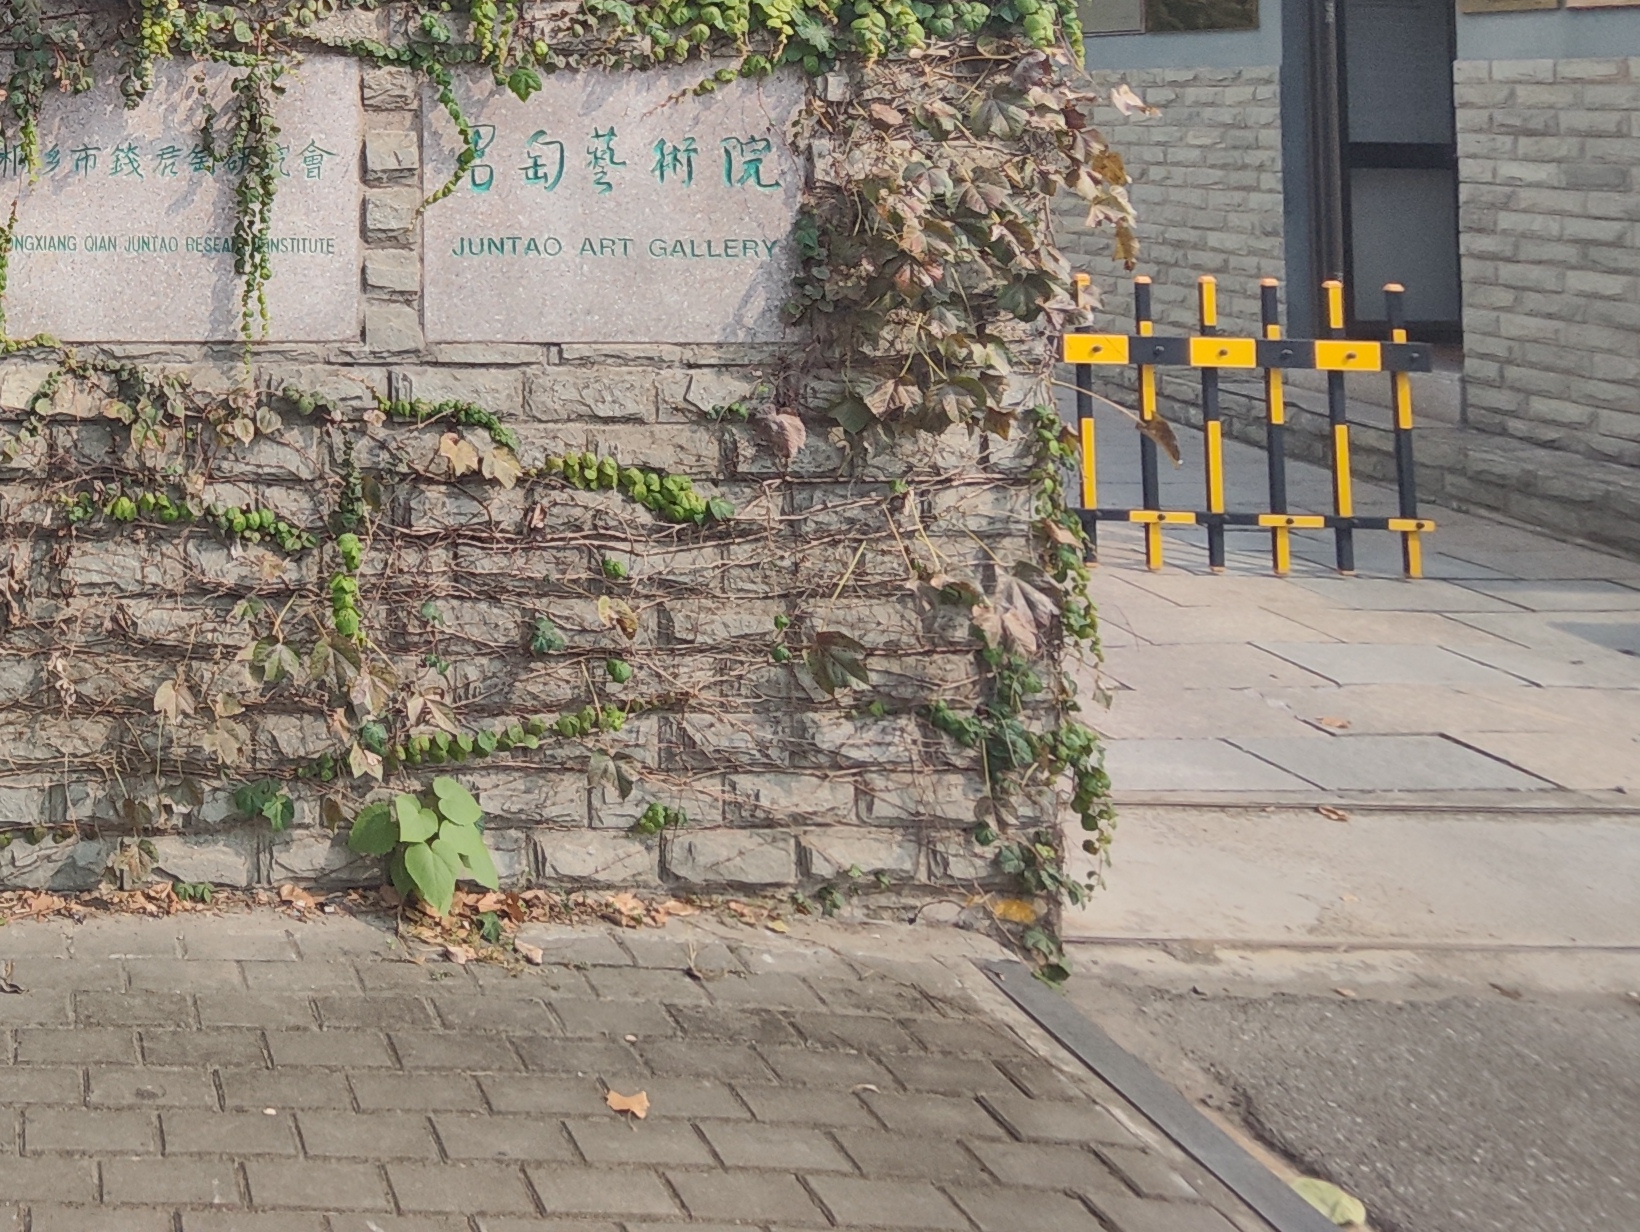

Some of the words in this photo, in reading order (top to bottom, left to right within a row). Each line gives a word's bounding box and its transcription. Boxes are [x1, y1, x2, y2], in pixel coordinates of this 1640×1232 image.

[8, 234, 77, 252] NGXIANG
[83, 234, 118, 253] QIAN
[124, 235, 179, 253] JUNTAO
[185, 236, 263, 254] RESEA
[451, 236, 562, 257] JUNTAO
[579, 237, 634, 257] ART
[647, 237, 779, 259] GALLERY
